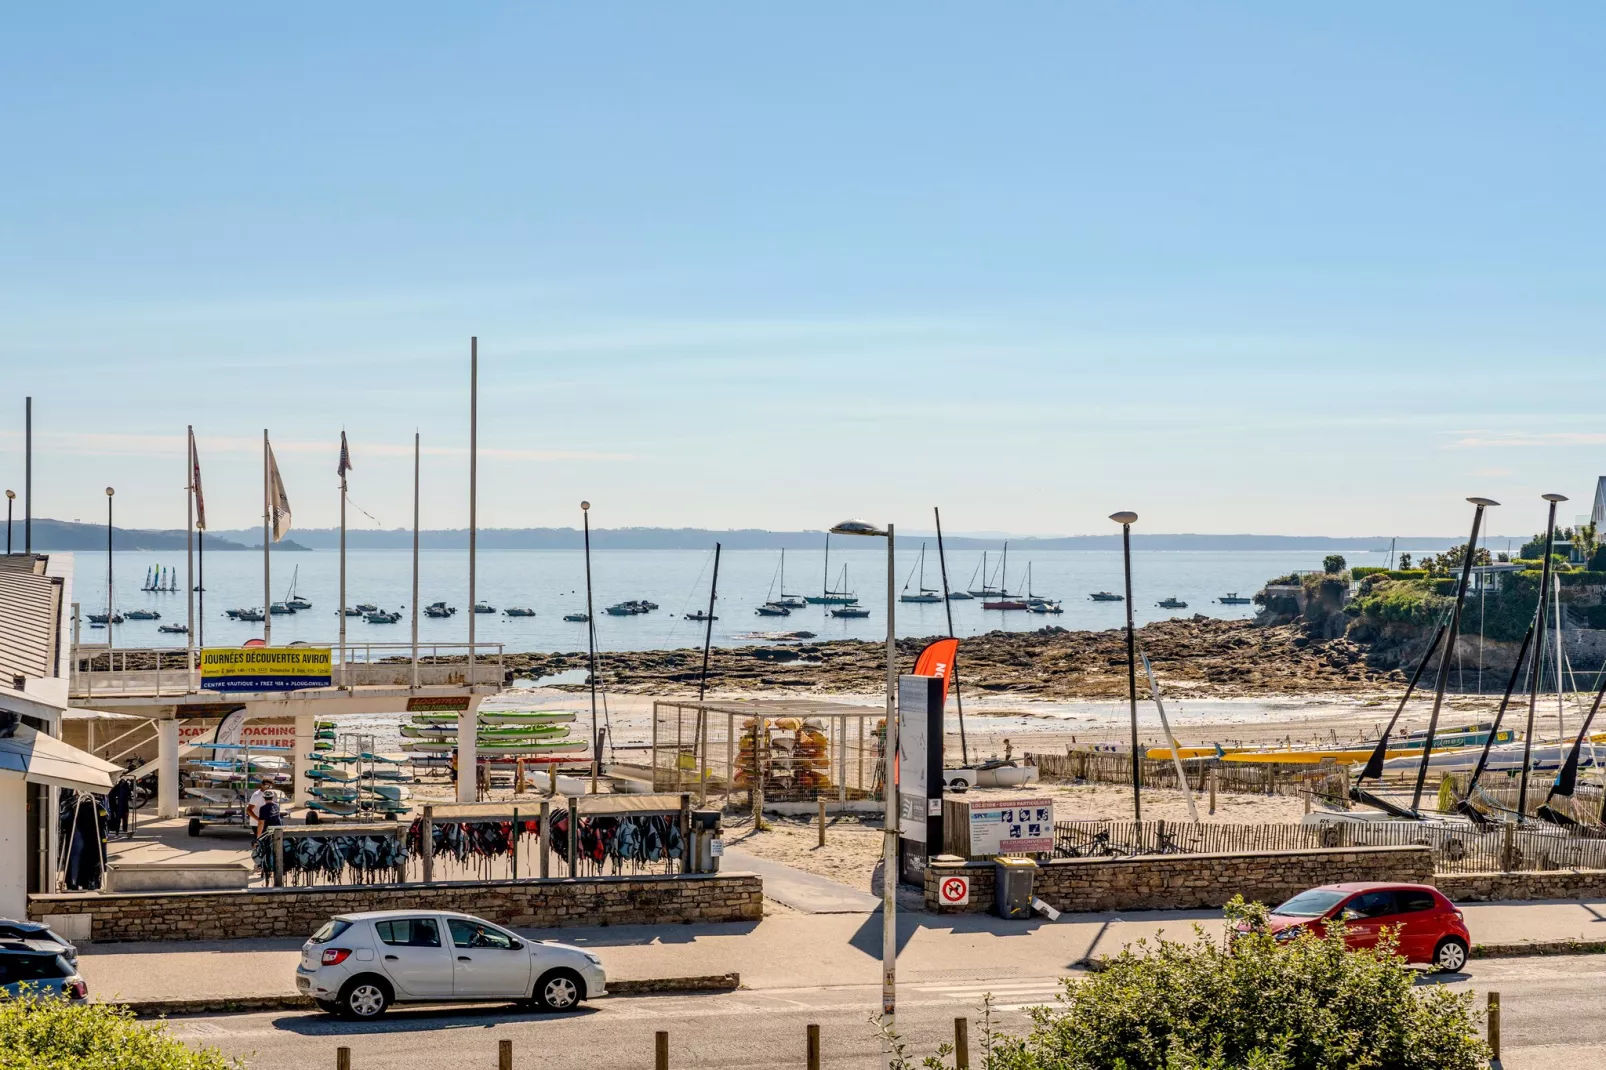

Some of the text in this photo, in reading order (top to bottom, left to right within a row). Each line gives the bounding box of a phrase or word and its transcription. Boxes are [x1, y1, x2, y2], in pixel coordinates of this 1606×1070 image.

[204, 652, 328, 664] JOURNÉES DÉCOUVERTES AVIRON
